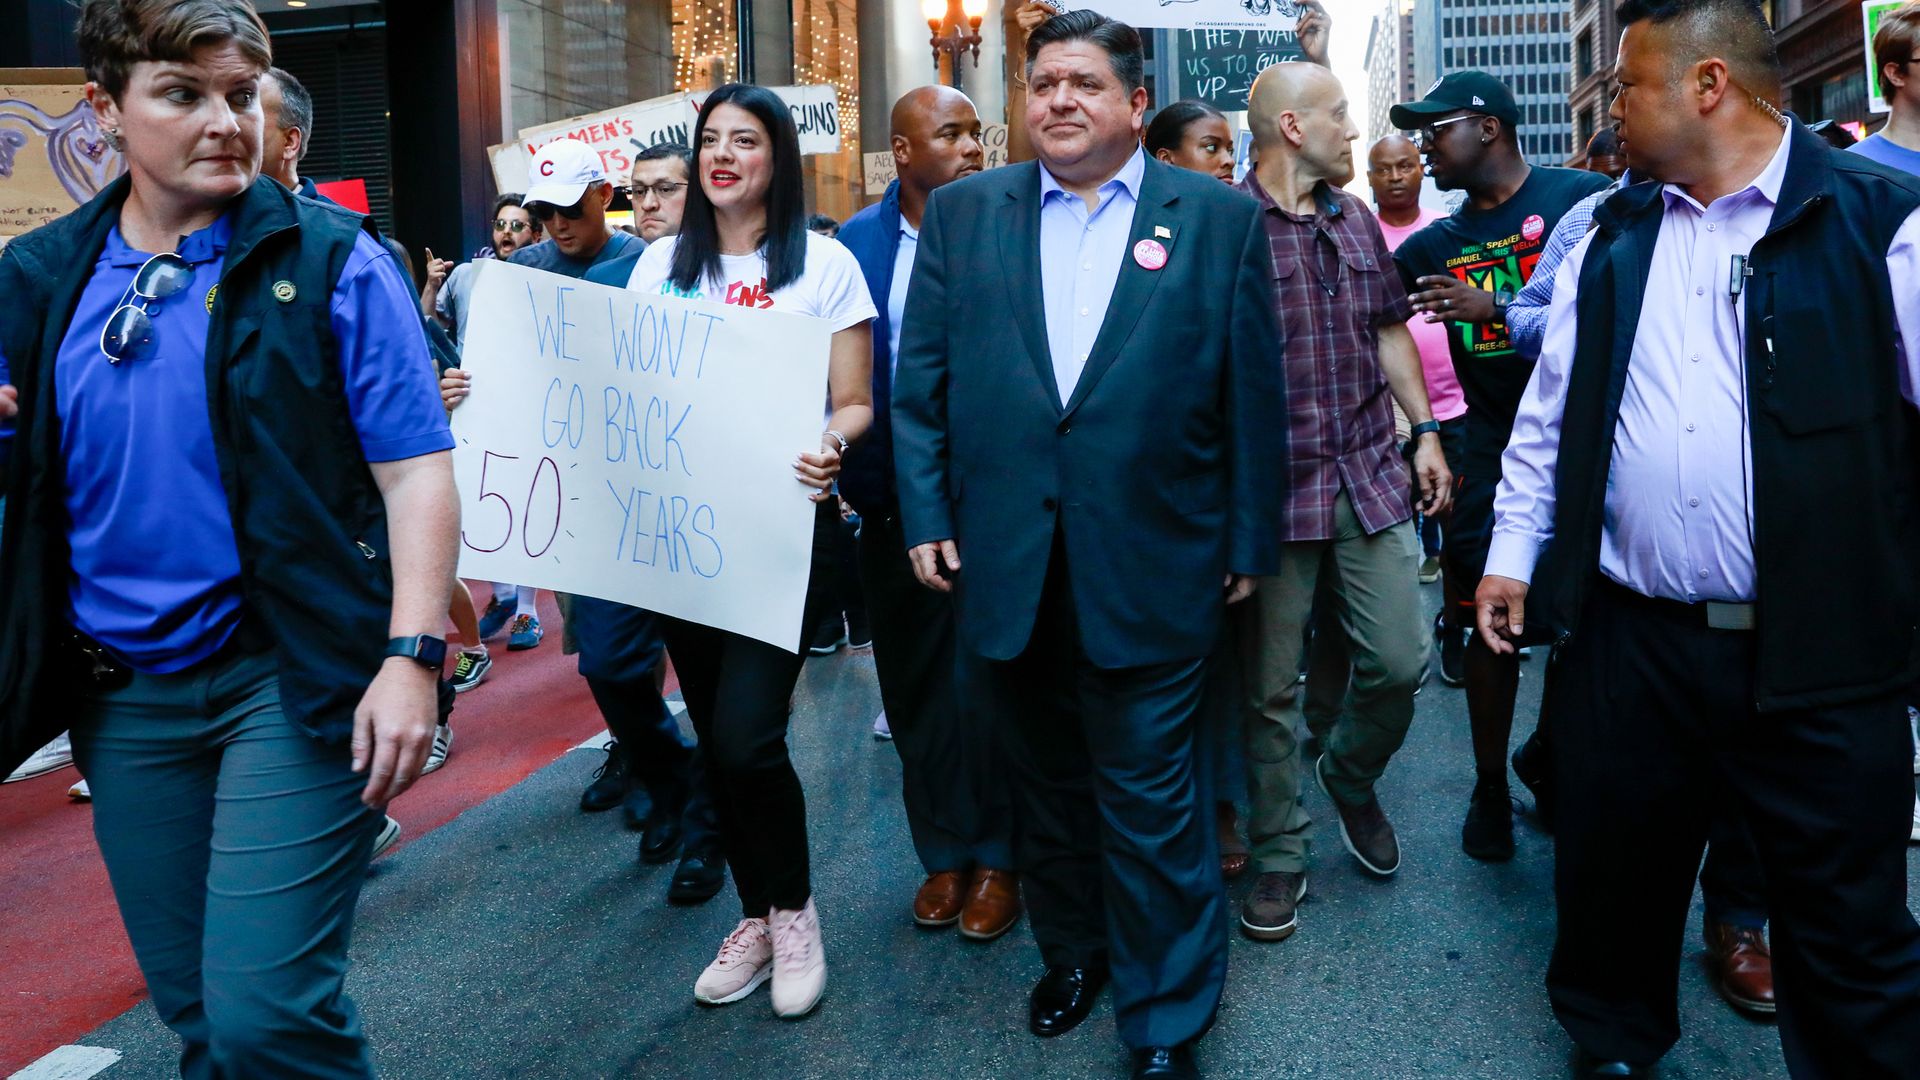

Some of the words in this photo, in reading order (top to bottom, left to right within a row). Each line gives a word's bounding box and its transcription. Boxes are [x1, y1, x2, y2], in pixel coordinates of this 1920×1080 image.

[1186, 28, 1247, 51] THEY
[1186, 57, 1210, 77] US
[1222, 54, 1248, 75] TO
[540, 160, 554, 176] C
[526, 281, 580, 362] WE
[608, 296, 724, 379] WON'T
[542, 377, 585, 450] GO
[604, 386, 692, 477] BACK
[461, 450, 562, 559] 50
[606, 479, 723, 578] YEARS
